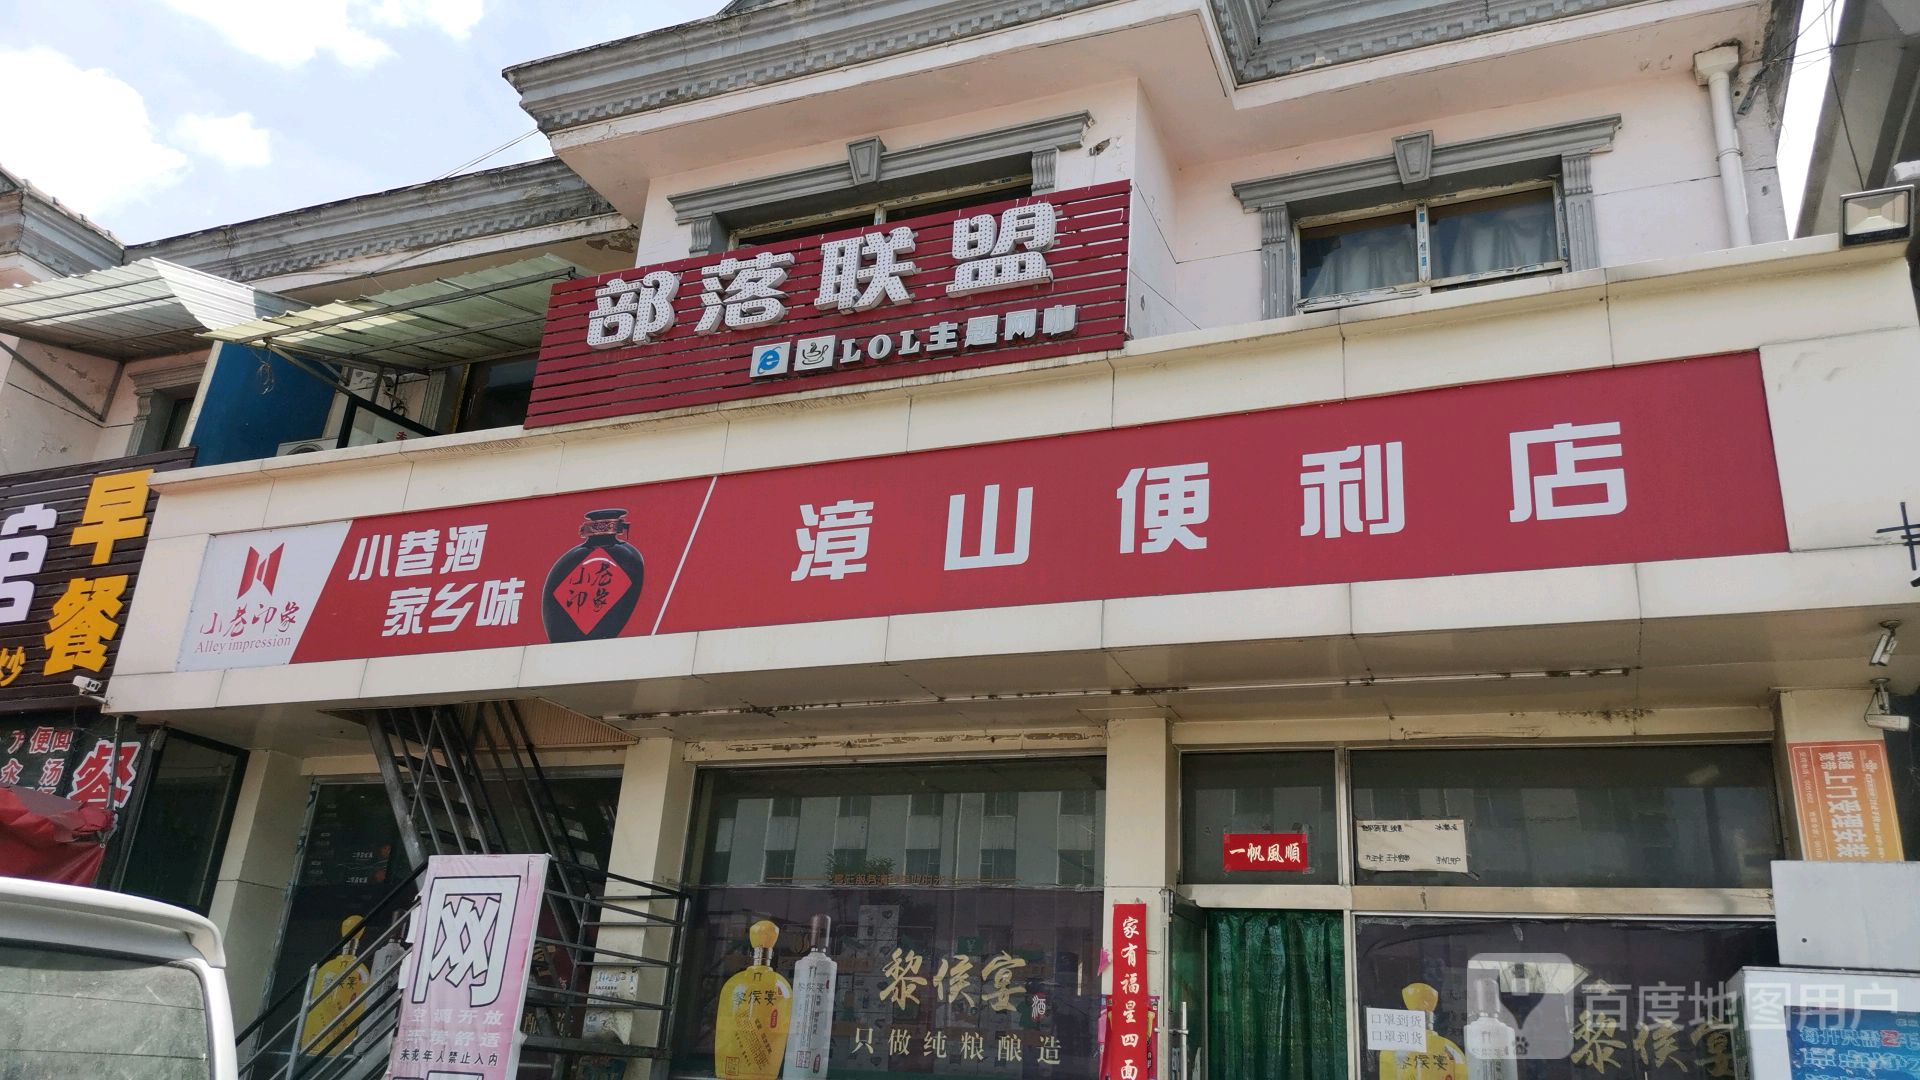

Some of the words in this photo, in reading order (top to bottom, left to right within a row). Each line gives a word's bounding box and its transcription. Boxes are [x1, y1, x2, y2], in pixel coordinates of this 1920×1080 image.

[586, 202, 1060, 349] 部落联盟
[791, 421, 1628, 581] 漳山便利店
[44, 468, 154, 676] 早餐
[348, 523, 488, 581] 小巷酒
[200, 601, 300, 638] 小巷印象
[381, 577, 525, 637] 家乡味
[194, 640, 227, 655] Alley
[228, 634, 291, 653] impression
[1229, 842, 1301, 864] 一帆風順
[412, 876, 521, 1007] 网
[879, 947, 1027, 1012] 黎侯宴
[1120, 916, 1140, 1080] 家有福星四面
[852, 1027, 1062, 1065] 只做纯粮酿造
[1371, 1013, 1421, 1028] 口罩到货
[1372, 1030, 1423, 1045] 口罩到货
[400, 1048, 498, 1066] 未成年人禁止入内
